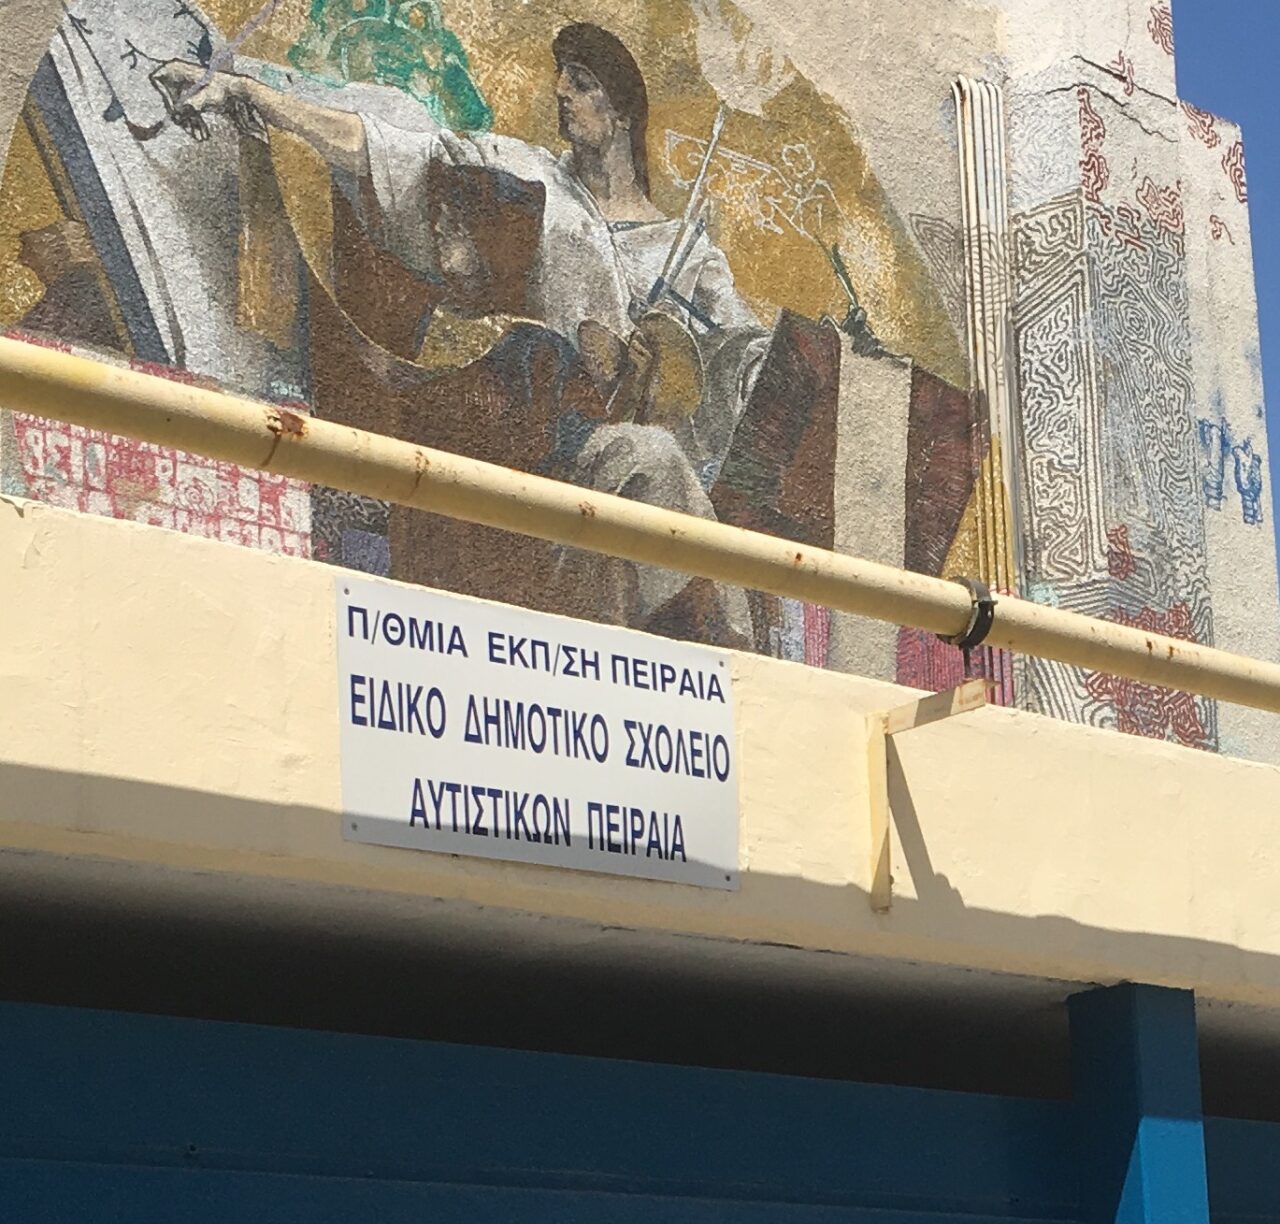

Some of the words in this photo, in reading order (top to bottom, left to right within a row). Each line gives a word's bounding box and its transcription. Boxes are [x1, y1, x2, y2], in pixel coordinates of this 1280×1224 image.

[347, 605, 468, 658] Π/ΘΜΙΑ
[487, 631, 601, 681] ΕΚΠ/ΣΗ
[611, 654, 726, 704] ΠΕΙΡΑΙΑ
[350, 673, 447, 739] ΕΙΔΙΚΟ
[464, 694, 609, 763] ΔΗΜΟΤΙΚΟ
[625, 719, 731, 782] ΣΧΟΛΕΙΟ
[408, 777, 572, 847] ΑΥΤΙΣΤΙΚΩΝ
[587, 802, 687, 863] ΠΕΙΡΑΙΑ
